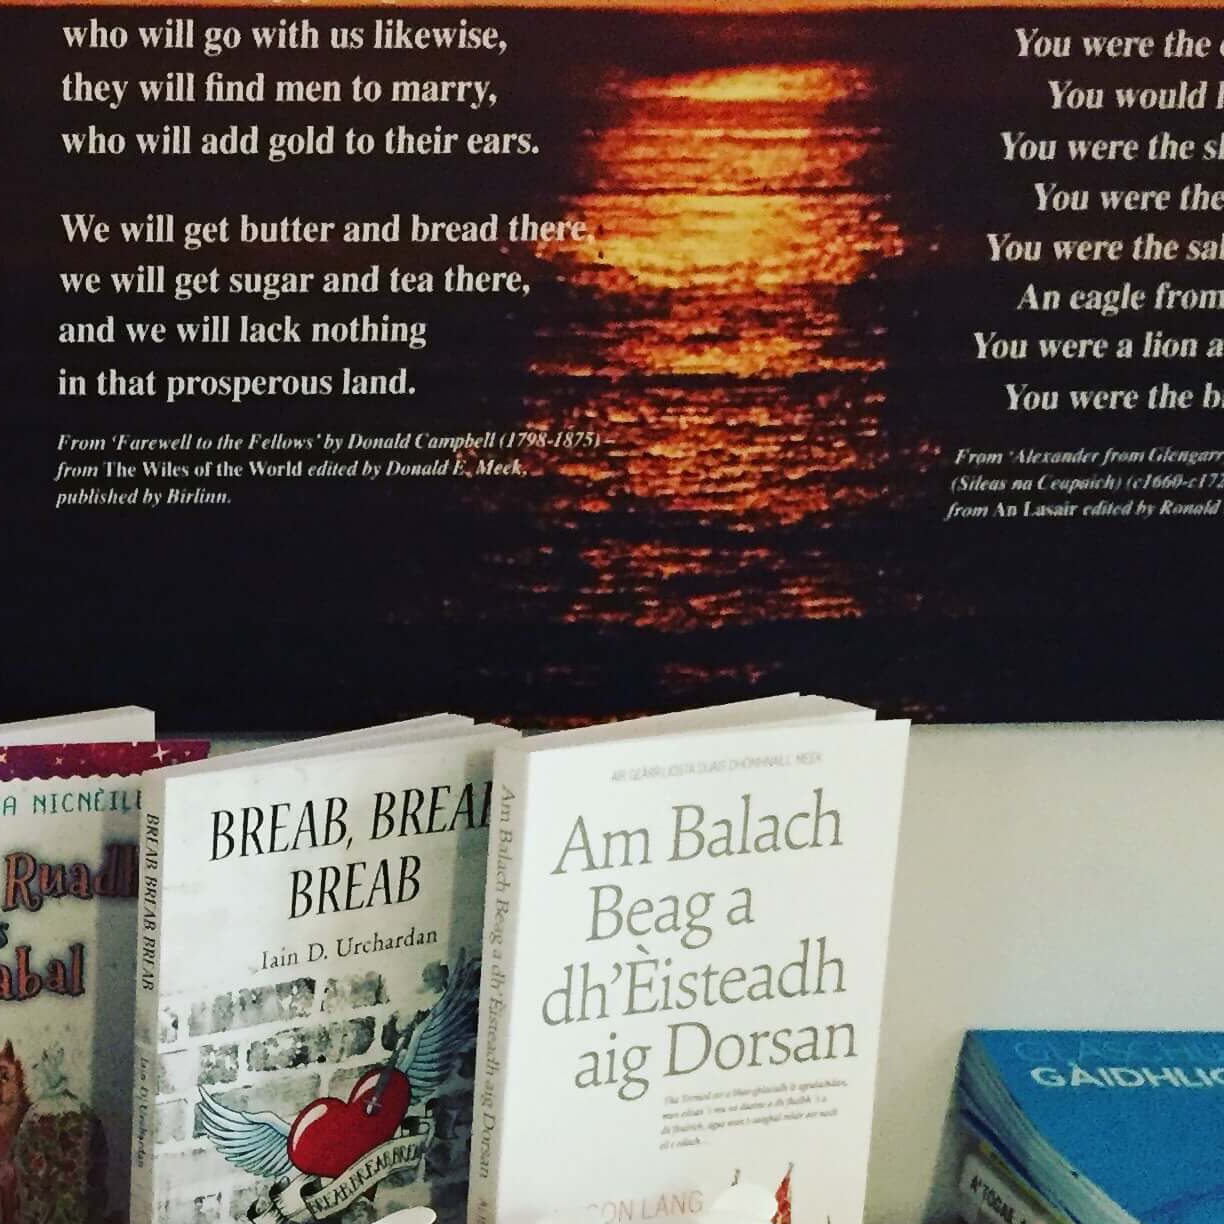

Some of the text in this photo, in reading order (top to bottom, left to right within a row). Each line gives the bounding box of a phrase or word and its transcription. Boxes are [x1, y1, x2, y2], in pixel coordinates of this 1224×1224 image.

[61, 214, 595, 250] We will get butter and bread there,
[1017, 282, 1224, 316] An eagle from
[59, 315, 426, 349] and we will lack nothing
[974, 331, 1197, 359] You were a lion
[59, 368, 415, 402] in that prosperous land.
[499, 784, 516, 822] Am
[208, 796, 353, 861] BREAB,
[550, 787, 844, 875] Am Balach
[495, 828, 514, 893] Balach
[141, 813, 160, 992] BREAB BREAB BREAB
[288, 854, 421, 920] BREAB
[490, 899, 511, 945] Beag
[586, 883, 755, 950] Beag a
[260, 926, 438, 971] Iain D. Urchardan
[574, 1032, 652, 1102] aig
[663, 1020, 859, 1078] Dorsan
[480, 1079, 498, 1107] aig
[479, 1111, 498, 1179] Dorsan
